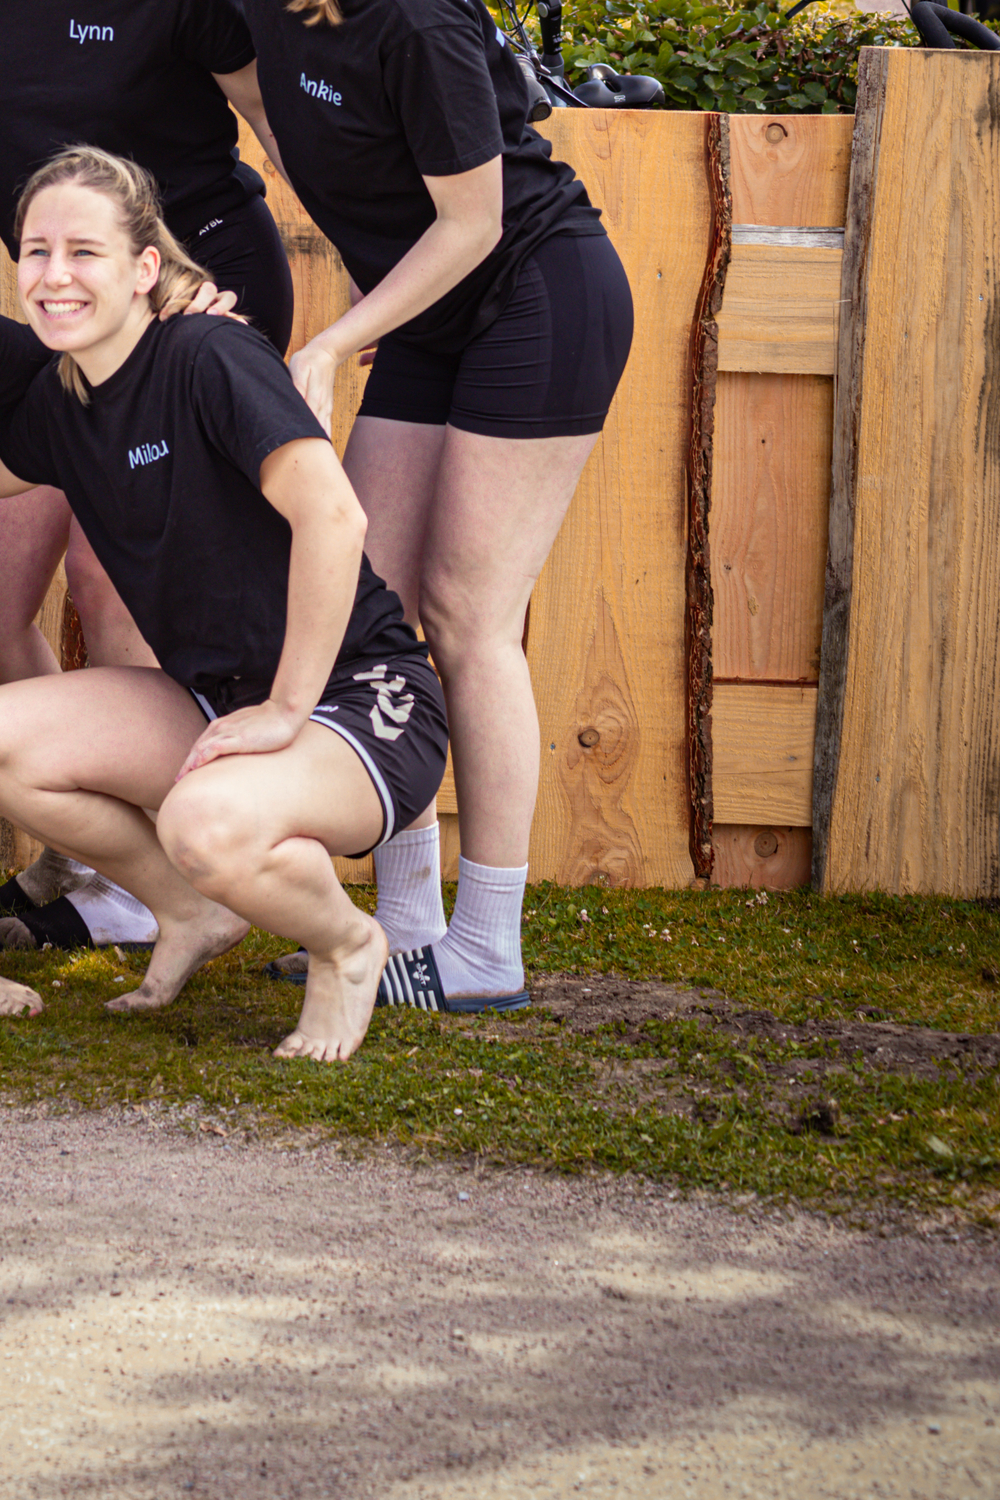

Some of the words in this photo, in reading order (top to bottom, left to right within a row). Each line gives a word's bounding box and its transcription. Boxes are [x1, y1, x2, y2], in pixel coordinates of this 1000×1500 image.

[69, 18, 114, 45] Lynn
[299, 71, 343, 107] Ankie
[198, 217, 224, 236] AYBL
[128, 439, 170, 470] Milou
